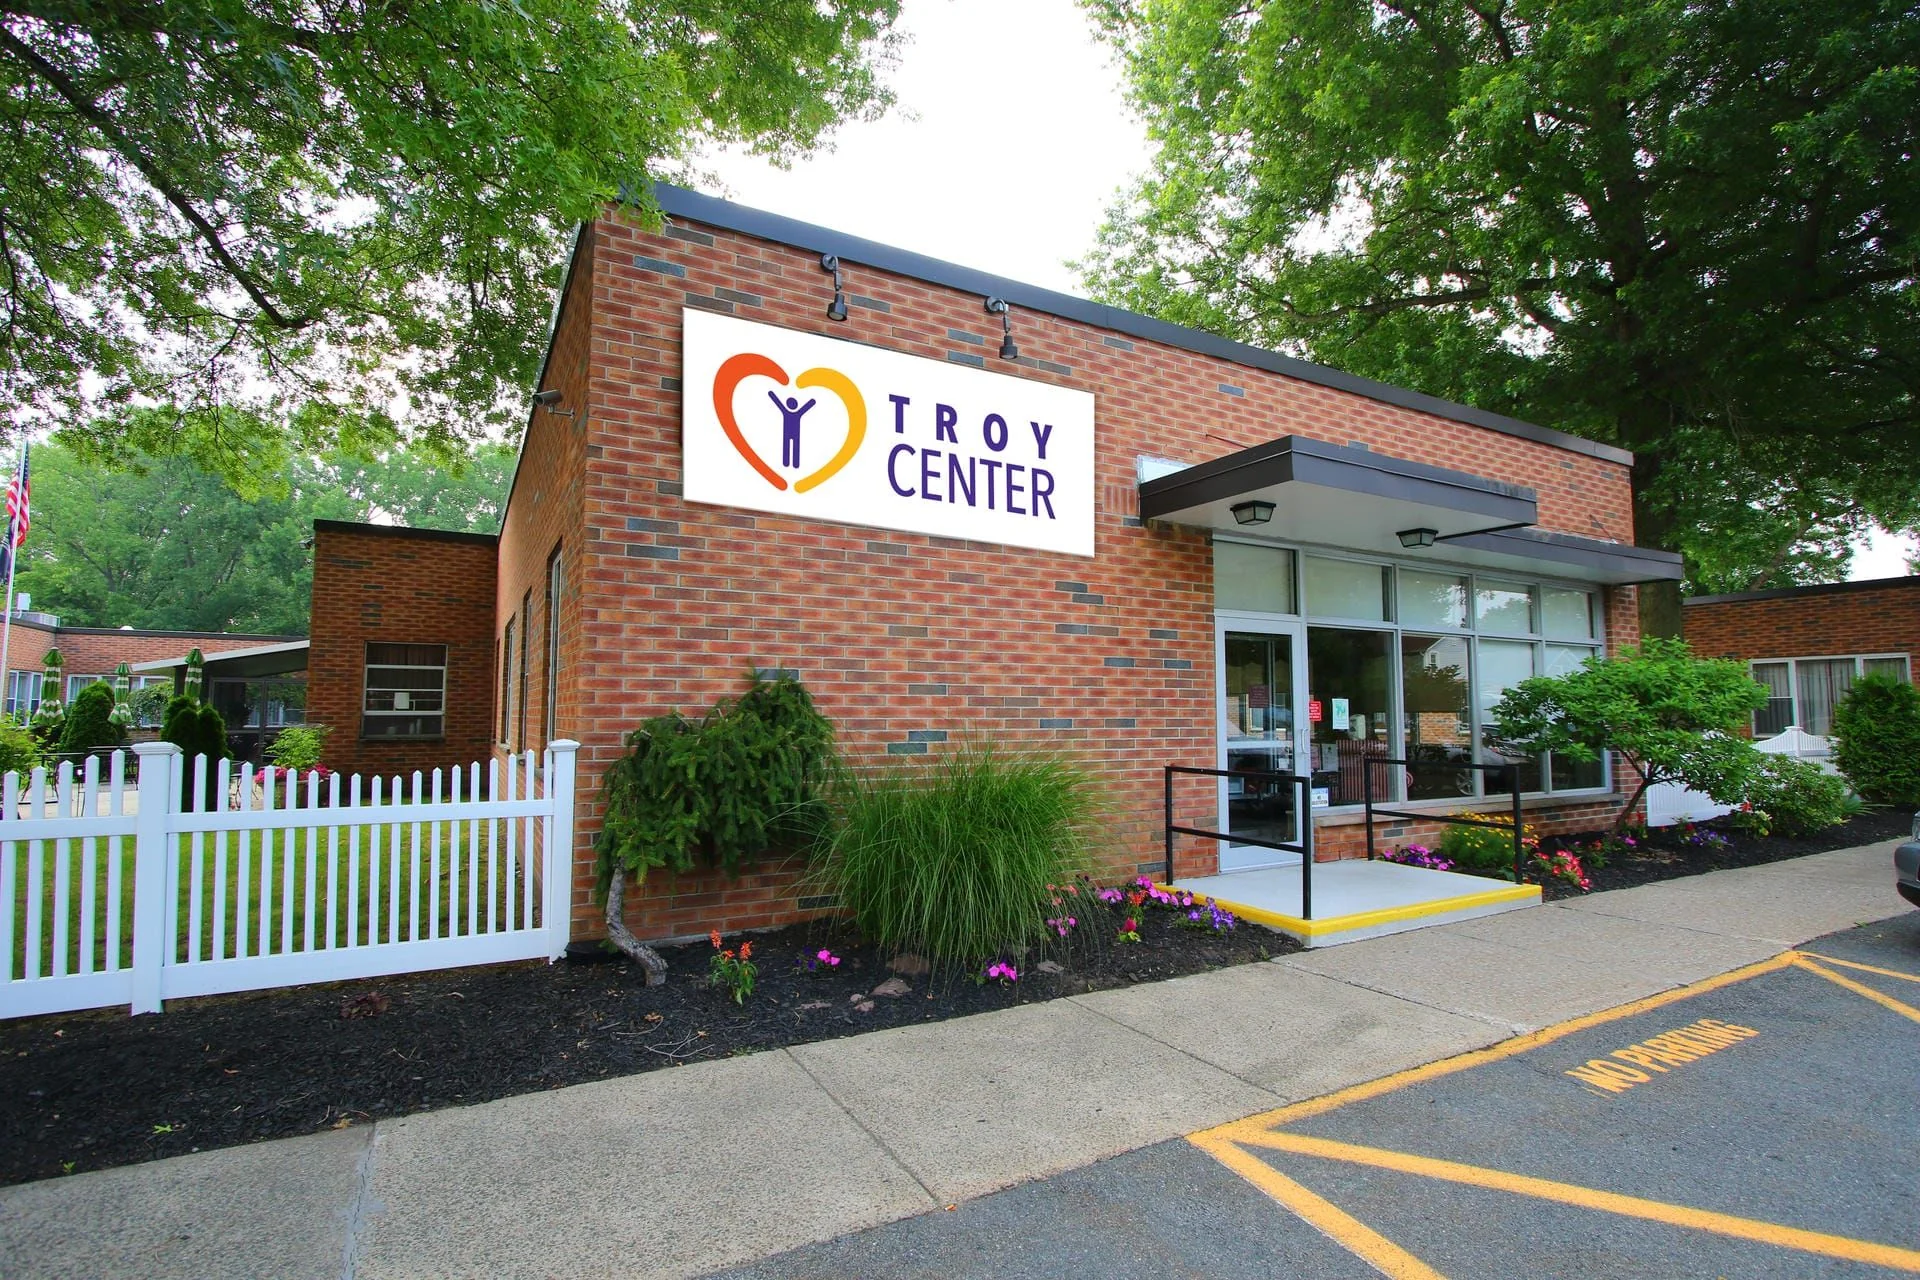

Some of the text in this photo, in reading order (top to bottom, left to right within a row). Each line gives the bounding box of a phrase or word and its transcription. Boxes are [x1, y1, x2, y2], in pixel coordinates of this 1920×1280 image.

[889, 394, 1053, 460] TROY
[887, 443, 1056, 519] CENTER
[1563, 1018, 1760, 1098] NO PARKING
